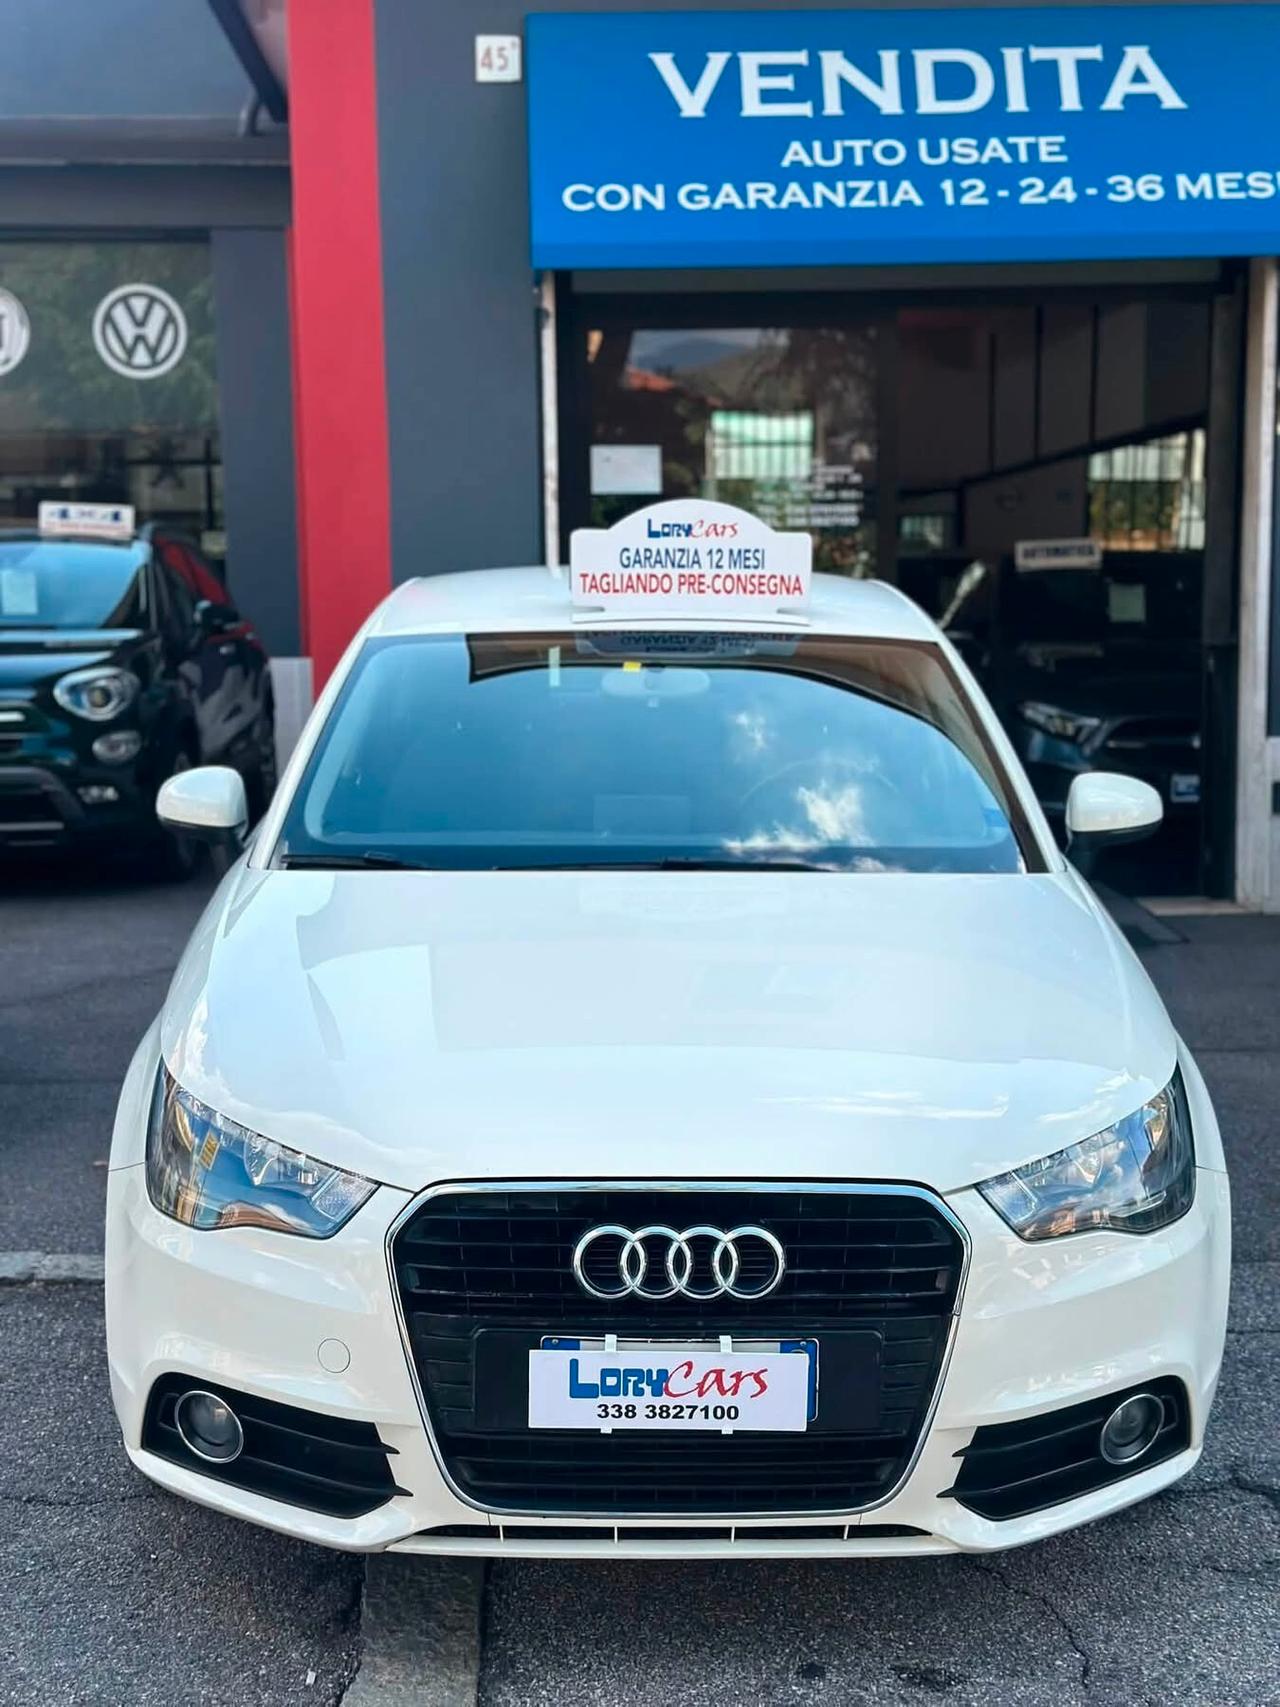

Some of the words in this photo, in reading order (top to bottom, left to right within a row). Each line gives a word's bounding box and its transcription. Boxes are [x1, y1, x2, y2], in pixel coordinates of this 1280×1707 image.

[650, 46, 1186, 117] VENDITA
[781, 139, 907, 167] AUTO
[918, 136, 1067, 165] USATE
[562, 183, 665, 212] CON
[677, 180, 923, 211] GARANZIA
[941, 178, 989, 206] 12
[1019, 177, 1077, 204] 24
[1107, 174, 1165, 202] 36
[619, 547, 702, 570] GARANZIA
[706, 548, 724, 570] 12
[728, 547, 766, 570] MESI
[580, 572, 673, 594] TAGLIANDO
[677, 573, 803, 596] PRE-CONSEGNA
[596, 1403, 637, 1419] 338
[644, 1404, 740, 1420] 3827100
